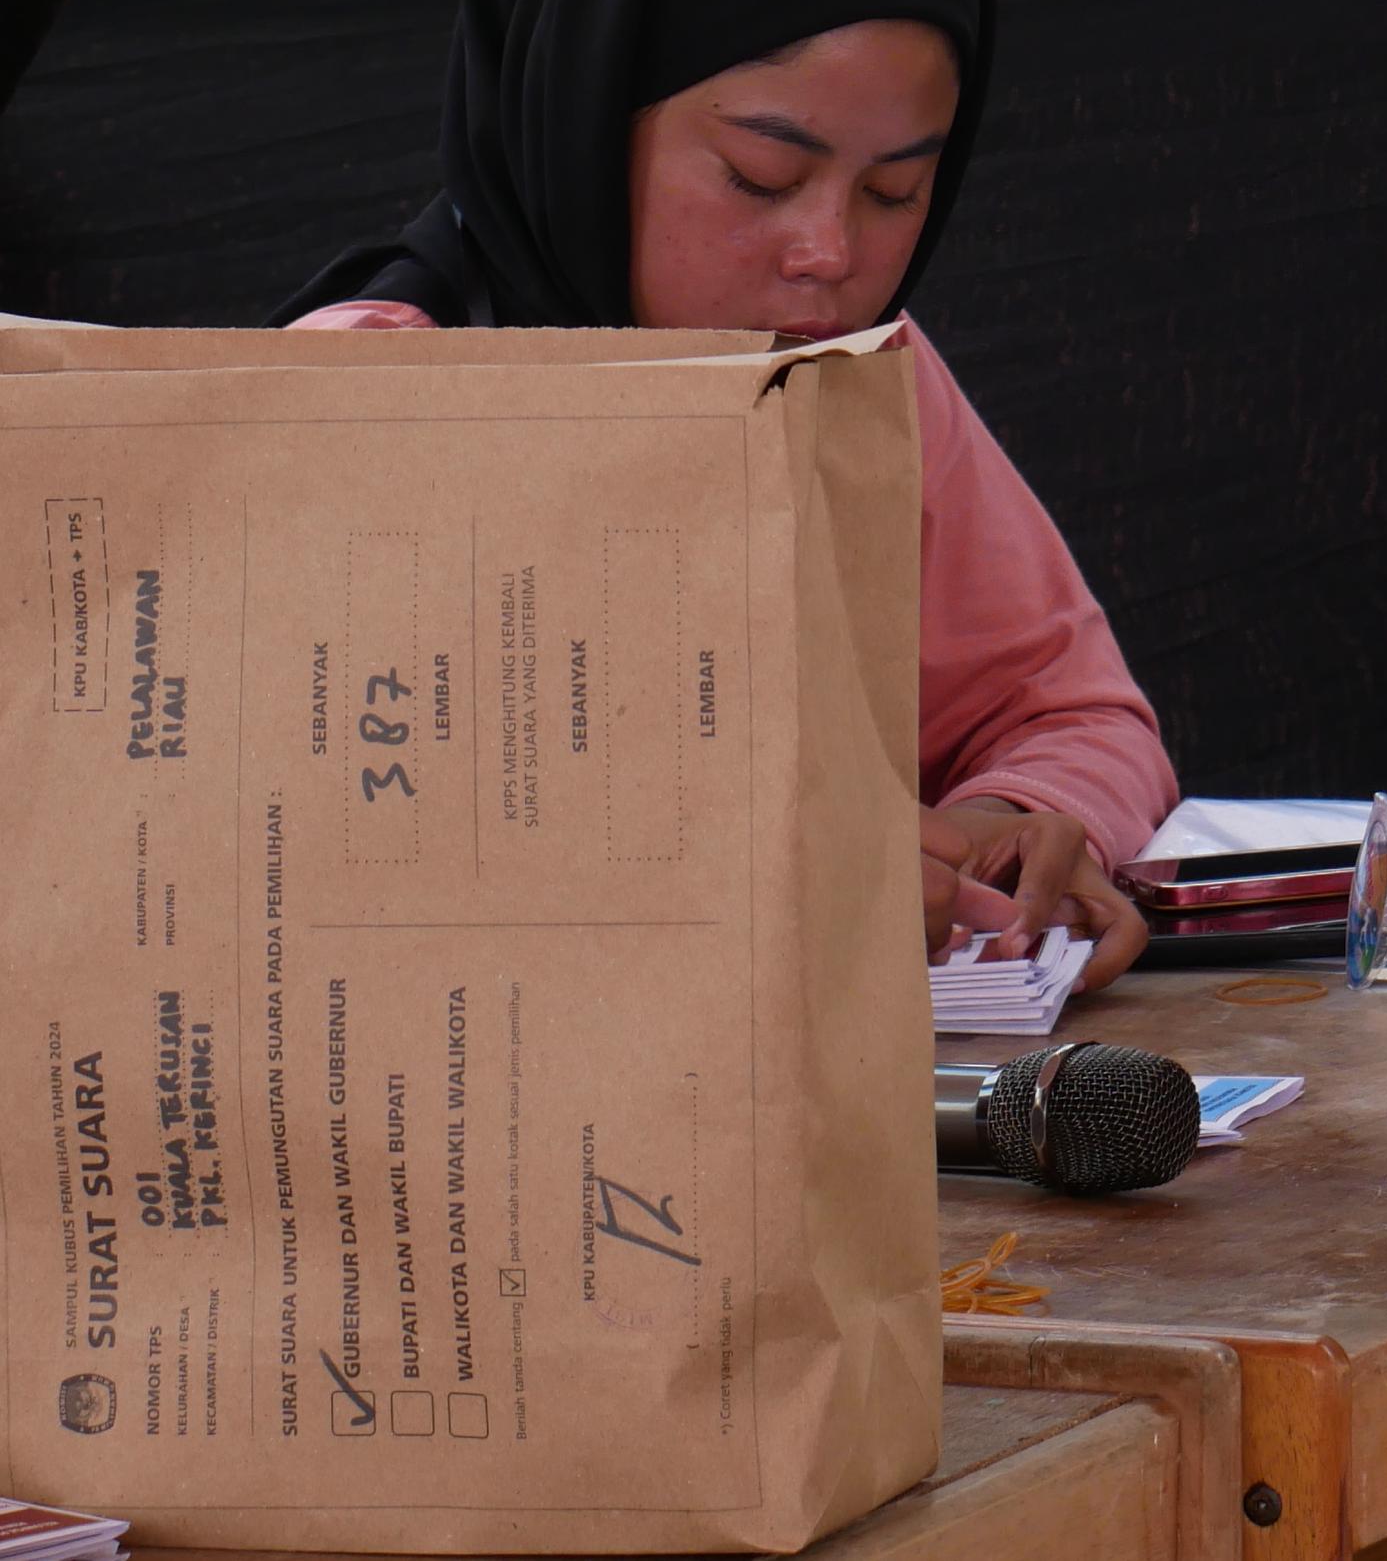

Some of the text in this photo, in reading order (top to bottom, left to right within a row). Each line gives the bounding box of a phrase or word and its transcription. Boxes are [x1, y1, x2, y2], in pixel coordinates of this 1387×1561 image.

[67, 511, 89, 697] KPU KAB/KOTA TPS
[125, 568, 161, 760] PELALAWAN
[159, 674, 188, 758] RIAU
[311, 640, 329, 755] SEBANYAK
[434, 651, 452, 741] LEMBAR
[500, 571, 518, 820] KPPS MENGHITUNG KEMBALI
[520, 563, 540, 828] SURAT SUARA YANG DITERIMA
[569, 637, 589, 753] SEBANYAK
[698, 648, 717, 738] LEMBAR
[357, 665, 417, 803] 387
[136, 819, 149, 856] KOTA
[136, 866, 149, 946] KABUPATEN
[164, 881, 177, 946] PROVINSI
[73, 1049, 114, 1197] SUARA
[156, 989, 197, 1230] KUALA TERUSAN
[189, 1021, 229, 1227] PKL. KERINCI
[266, 802, 299, 1436] SURAT SUARA UNTUK PEMUNGUTAN SUARA PADA PEMILIHAN
[47, 1019, 80, 1349] SAMPUL KUBUS PEMILIHAN TAHUN 2024
[328, 976, 362, 1379] GUBERNUR DAN WAKIL GUBERNUR
[387, 1072, 421, 1379] BUPATI DAN WAKIL BUPATI
[447, 984, 475, 1382] WALIKOTA DAN WAKIL WALIKOTA
[506, 980, 528, 1440] Berilah tanda centang pada salah satu kotak sesuai jenis pemilihan
[582, 1122, 597, 1301] KPU KABUPATEN/KOTA
[86, 1209, 119, 1349] SURAT
[178, 1305, 191, 1342] DESA
[206, 1286, 221, 1339] DISTRIK
[718, 1314, 732, 1347] tidak
[719, 1276, 735, 1310] perlu
[146, 1323, 163, 1435] NOMOR TPS
[177, 1352, 190, 1435] KELURAHAN
[205, 1350, 219, 1435] KECAMATAN
[719, 1349, 735, 1380] yang
[719, 1381, 733, 1419] Coret
